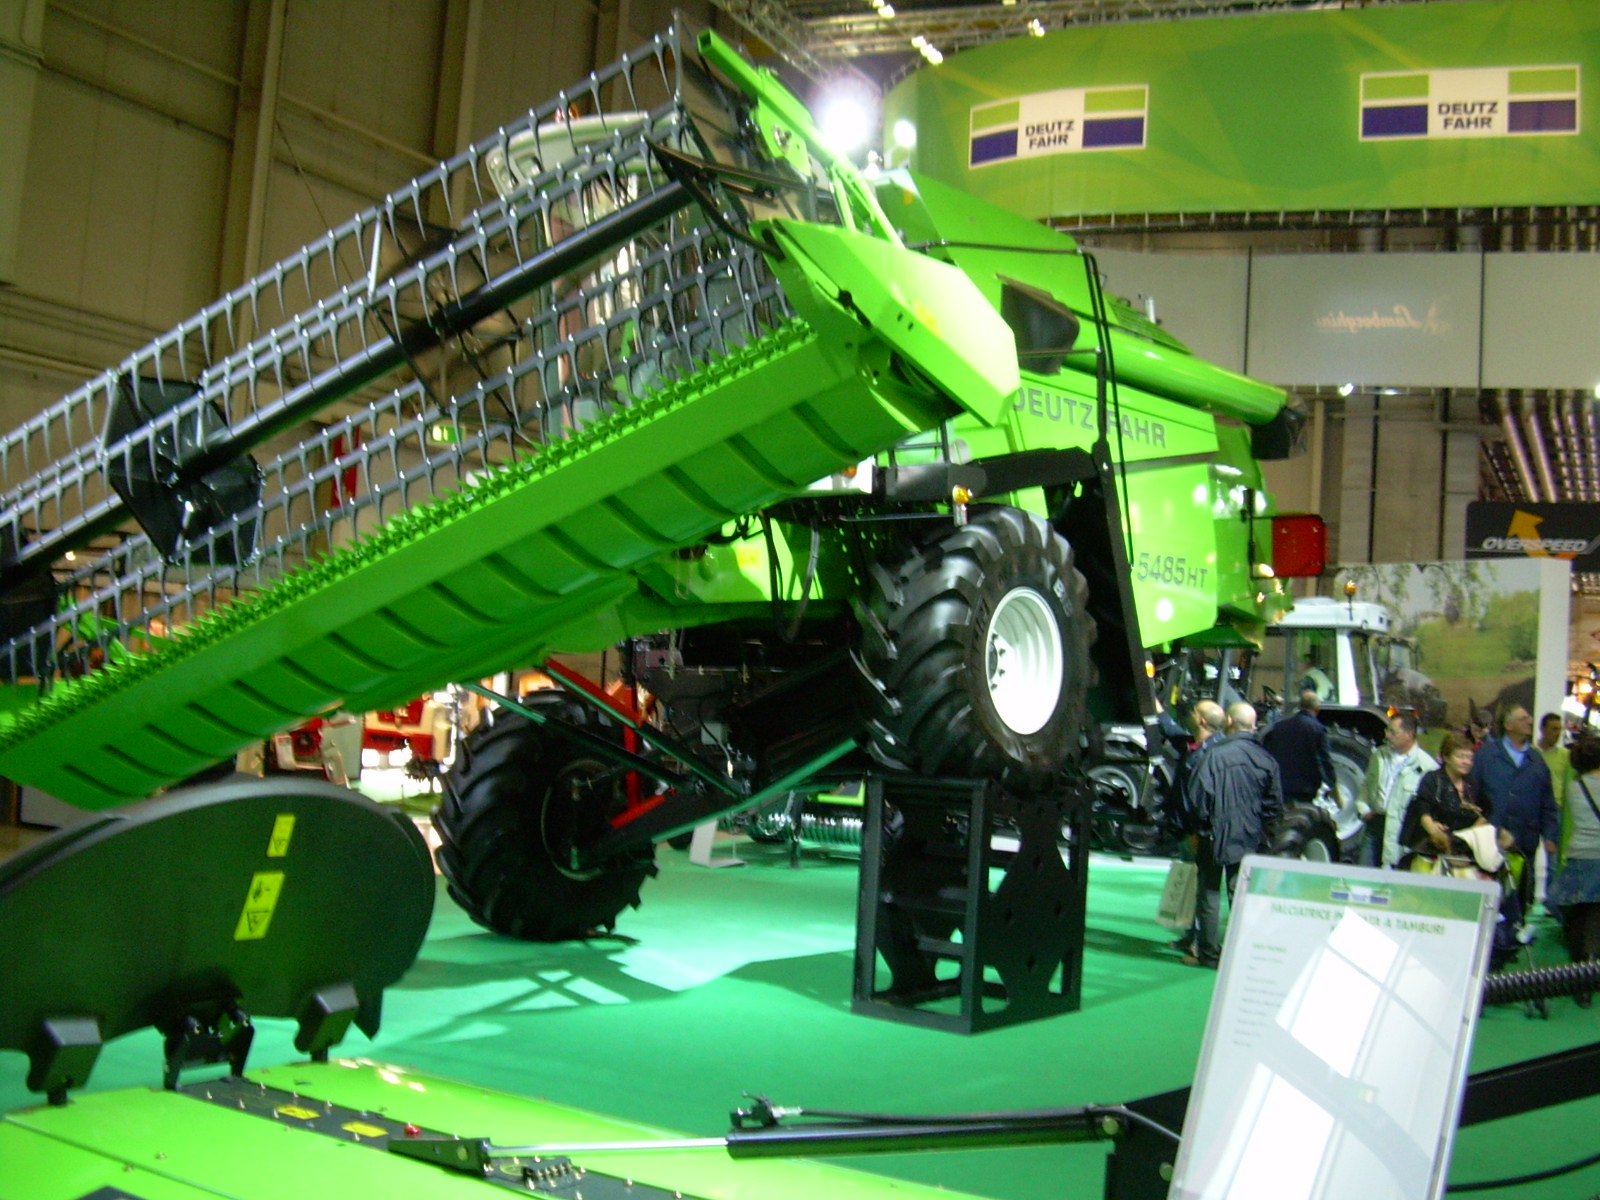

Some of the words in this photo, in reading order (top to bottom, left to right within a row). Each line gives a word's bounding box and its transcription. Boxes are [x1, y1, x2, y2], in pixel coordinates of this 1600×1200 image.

[1437, 101, 1499, 116] DEUTZ
[1025, 120, 1075, 137] DEUTZ
[1443, 117, 1492, 129] FAHR
[1029, 134, 1069, 149] FAHR
[1106, 409, 1166, 449] FAHR
